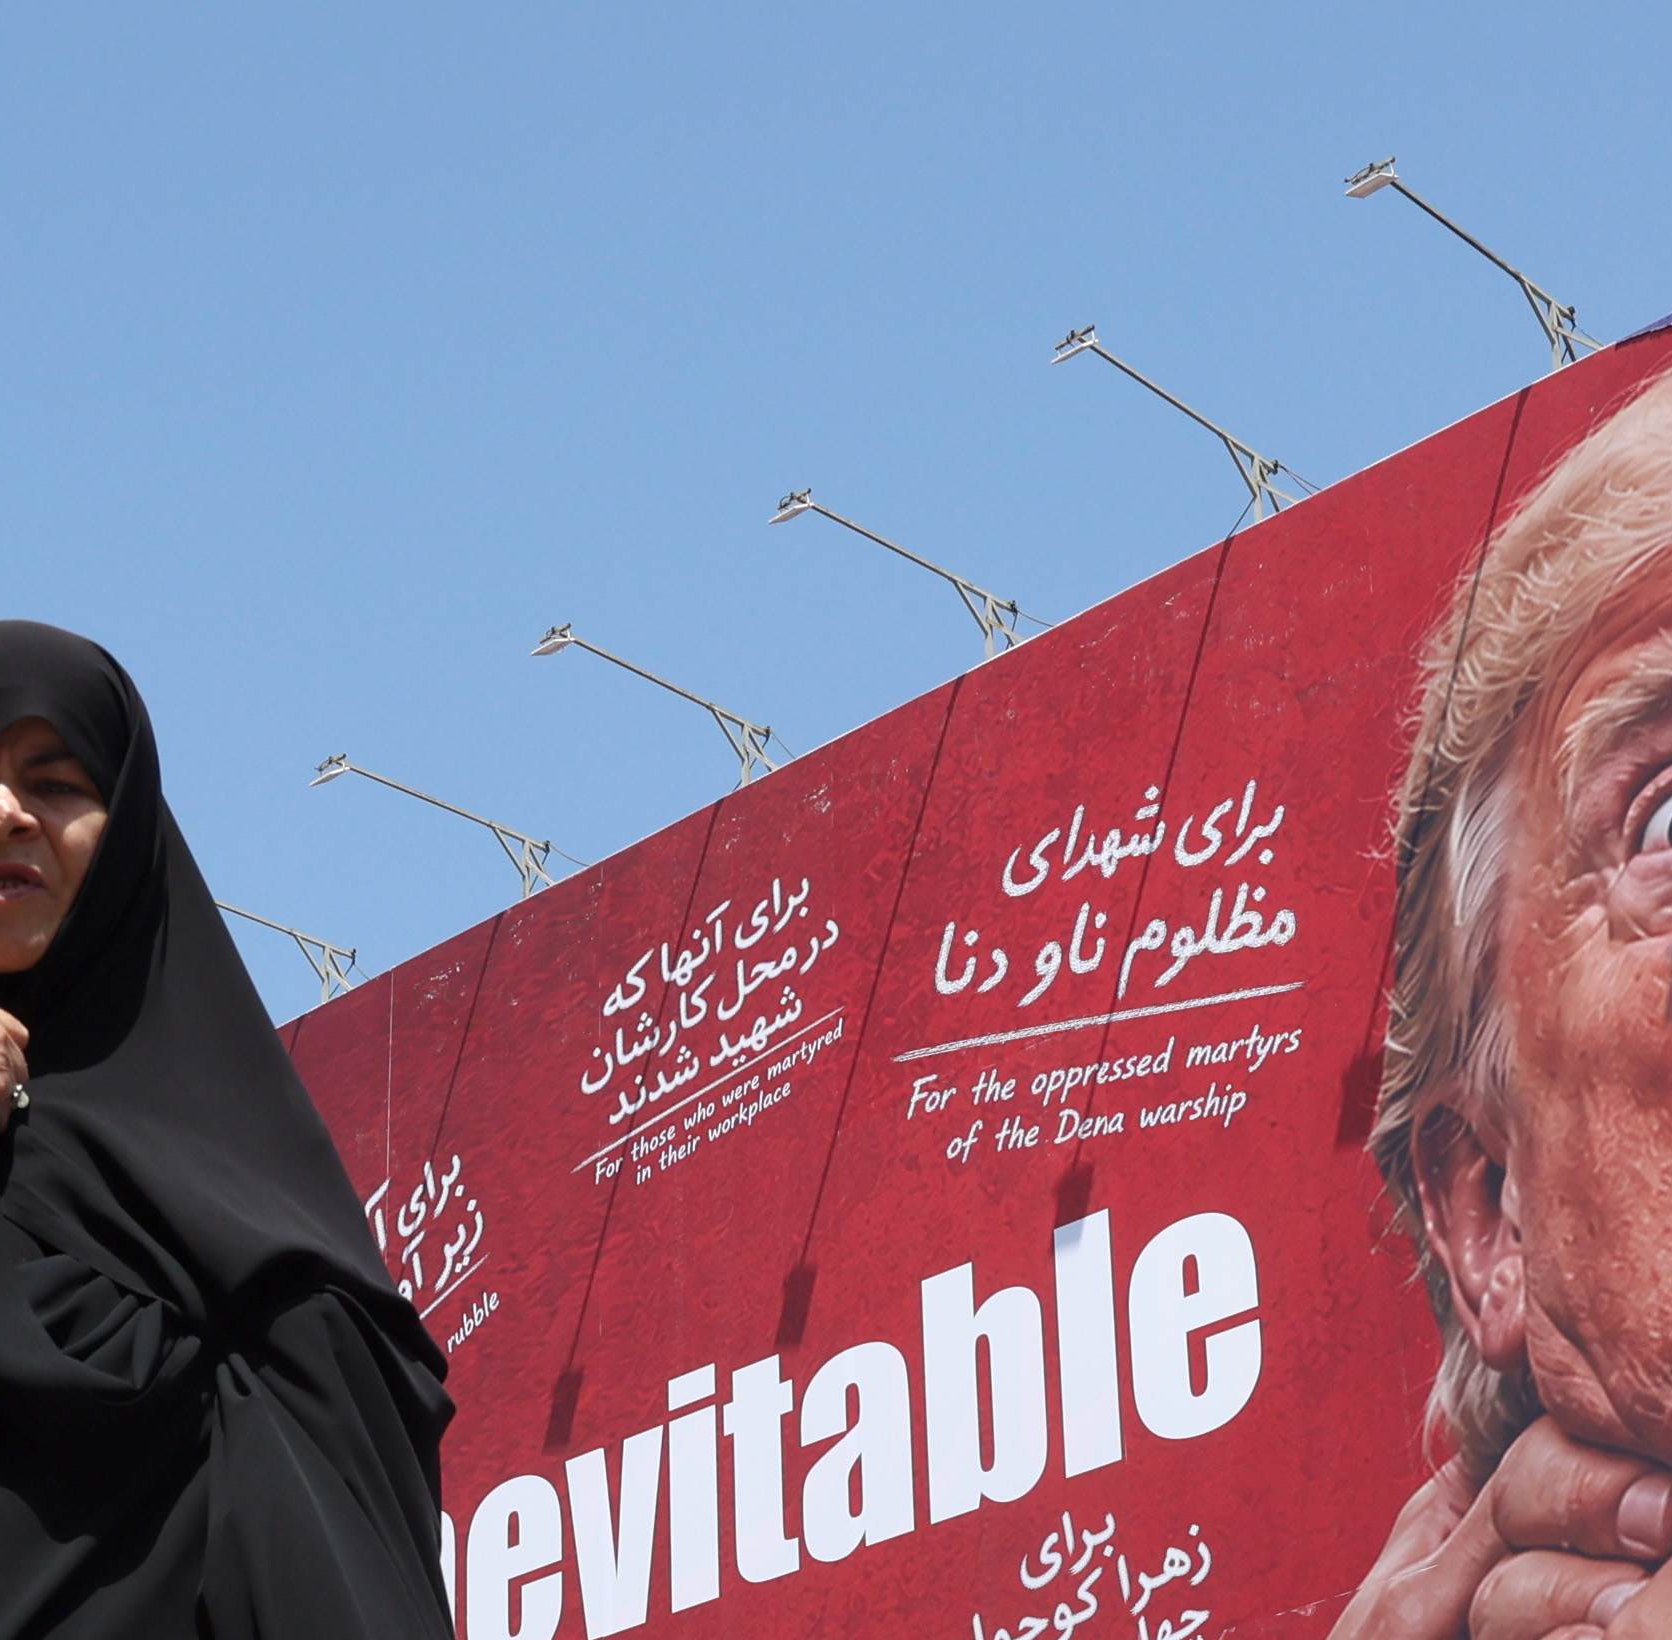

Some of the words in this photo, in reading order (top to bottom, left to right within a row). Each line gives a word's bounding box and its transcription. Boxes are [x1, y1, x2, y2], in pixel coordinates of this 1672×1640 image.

[1002, 784, 1166, 900] شهدای
[1174, 779, 1287, 867] برای
[734, 875, 811, 951] برای
[1018, 901, 1107, 1009] ناو
[1117, 883, 1299, 999] مظلوم
[932, 920, 1008, 997] دنا
[708, 986, 803, 1073] شهید
[908, 1074, 956, 1119] For
[972, 1069, 1016, 1105] the
[1031, 1037, 1174, 1106] oppressed
[1186, 1025, 1302, 1072] martyrs
[596, 1158, 623, 1184] For
[631, 1126, 675, 1161] those
[684, 1102, 715, 1130] who
[722, 1076, 759, 1107] were
[768, 1018, 842, 1080] martyred
[608, 1050, 699, 1128] شدند
[947, 1120, 983, 1163] of
[995, 1116, 1039, 1151] the
[1054, 1109, 1124, 1144] Dena
[1140, 1083, 1246, 1128] warship
[637, 1165, 651, 1184] in
[659, 1135, 700, 1170] their
[709, 1083, 790, 1141] workplace
[397, 1154, 465, 1237] برای
[433, 1198, 484, 1293] زیر
[446, 1291, 500, 1353] rubble
[1020, 1510, 1116, 1591] برای
[1114, 1522, 1212, 1613] زهرا
